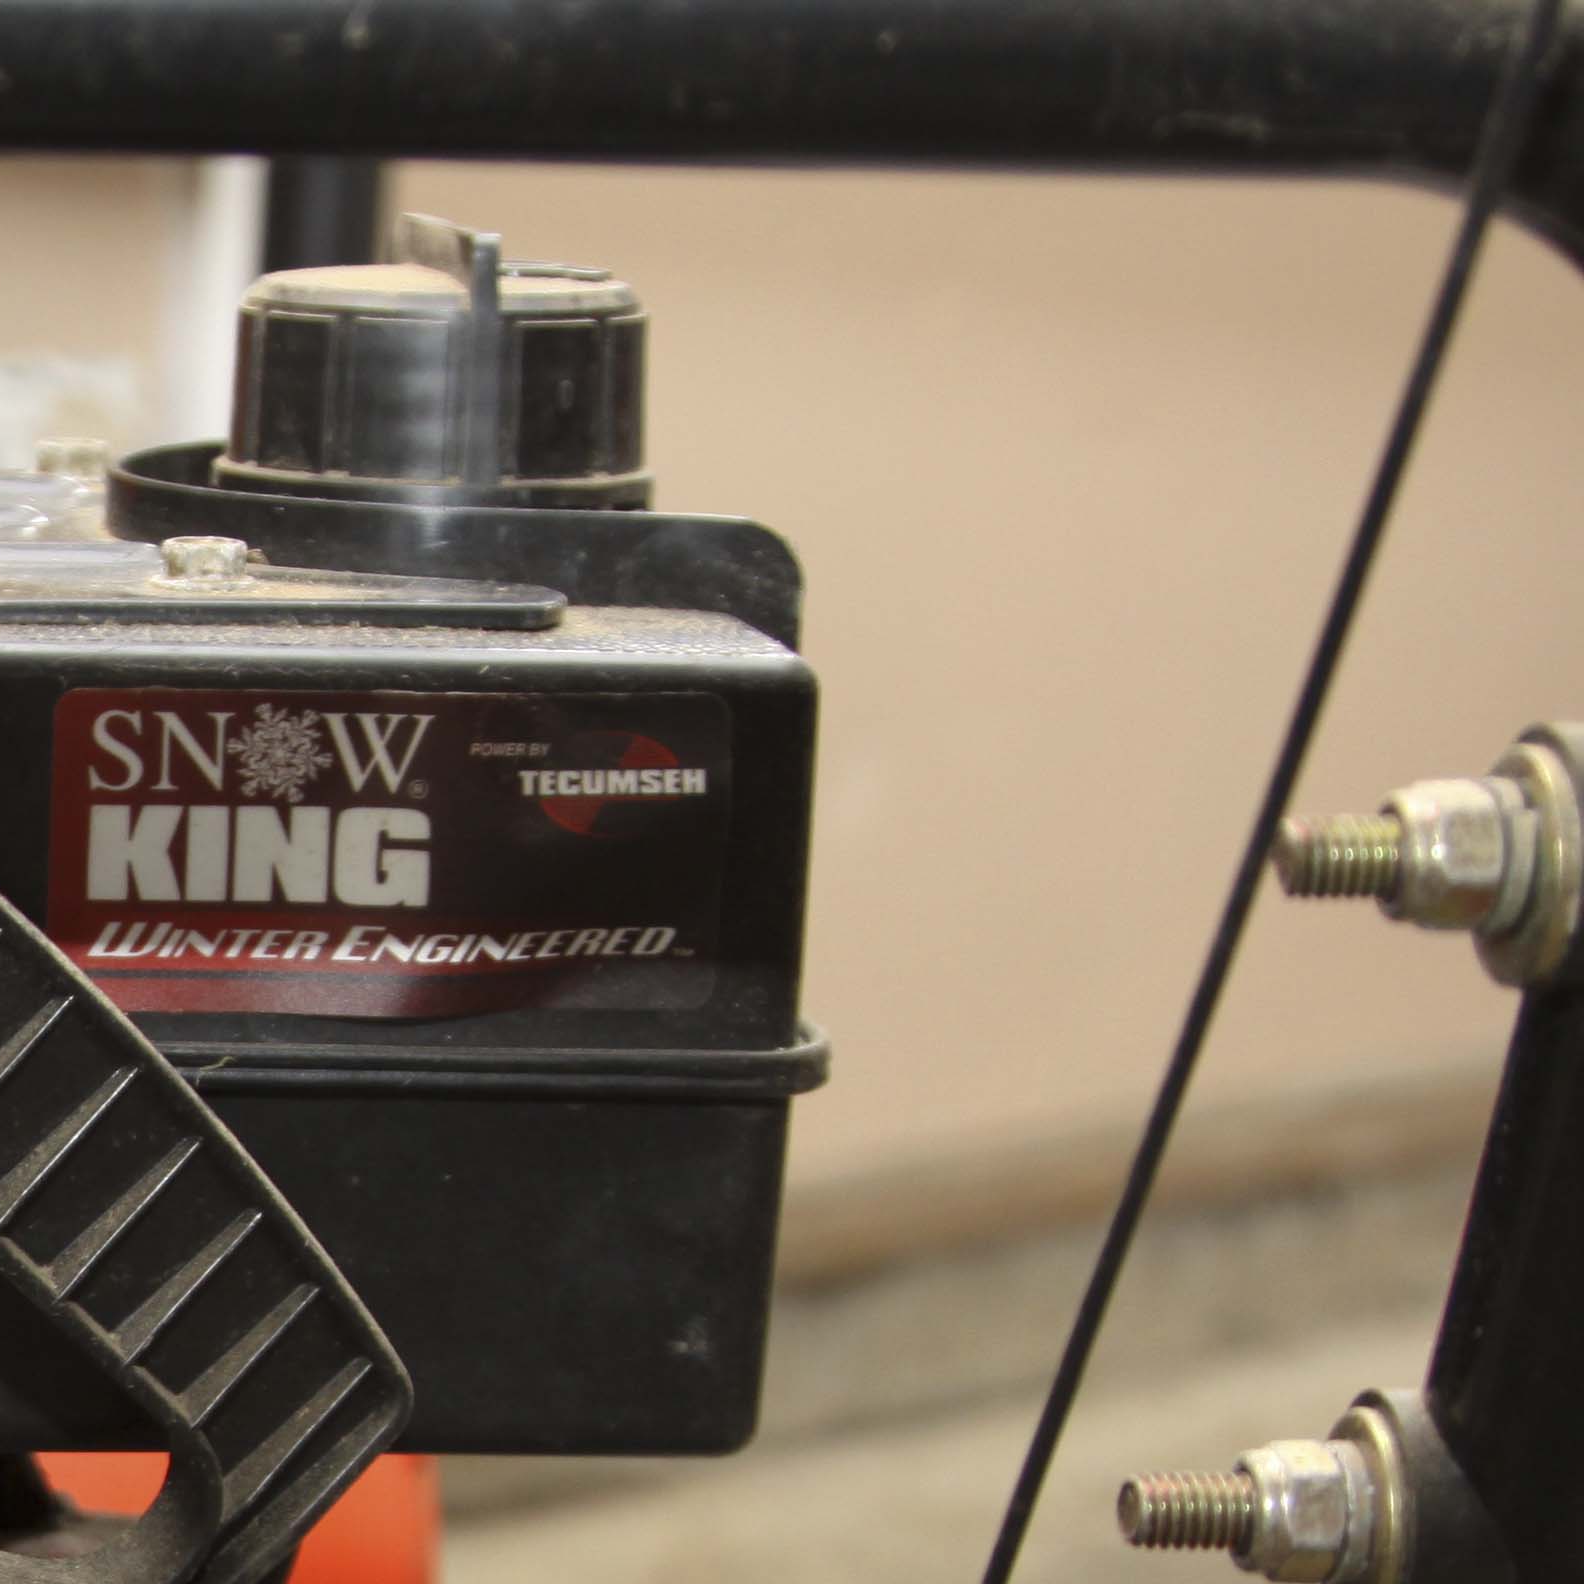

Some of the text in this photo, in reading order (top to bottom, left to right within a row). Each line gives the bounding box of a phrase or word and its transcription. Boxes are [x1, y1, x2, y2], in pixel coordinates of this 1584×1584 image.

[518, 769, 707, 796] TECUMSEH
[87, 804, 432, 908] KING
[87, 921, 677, 966] WINTER ENGINEERED
